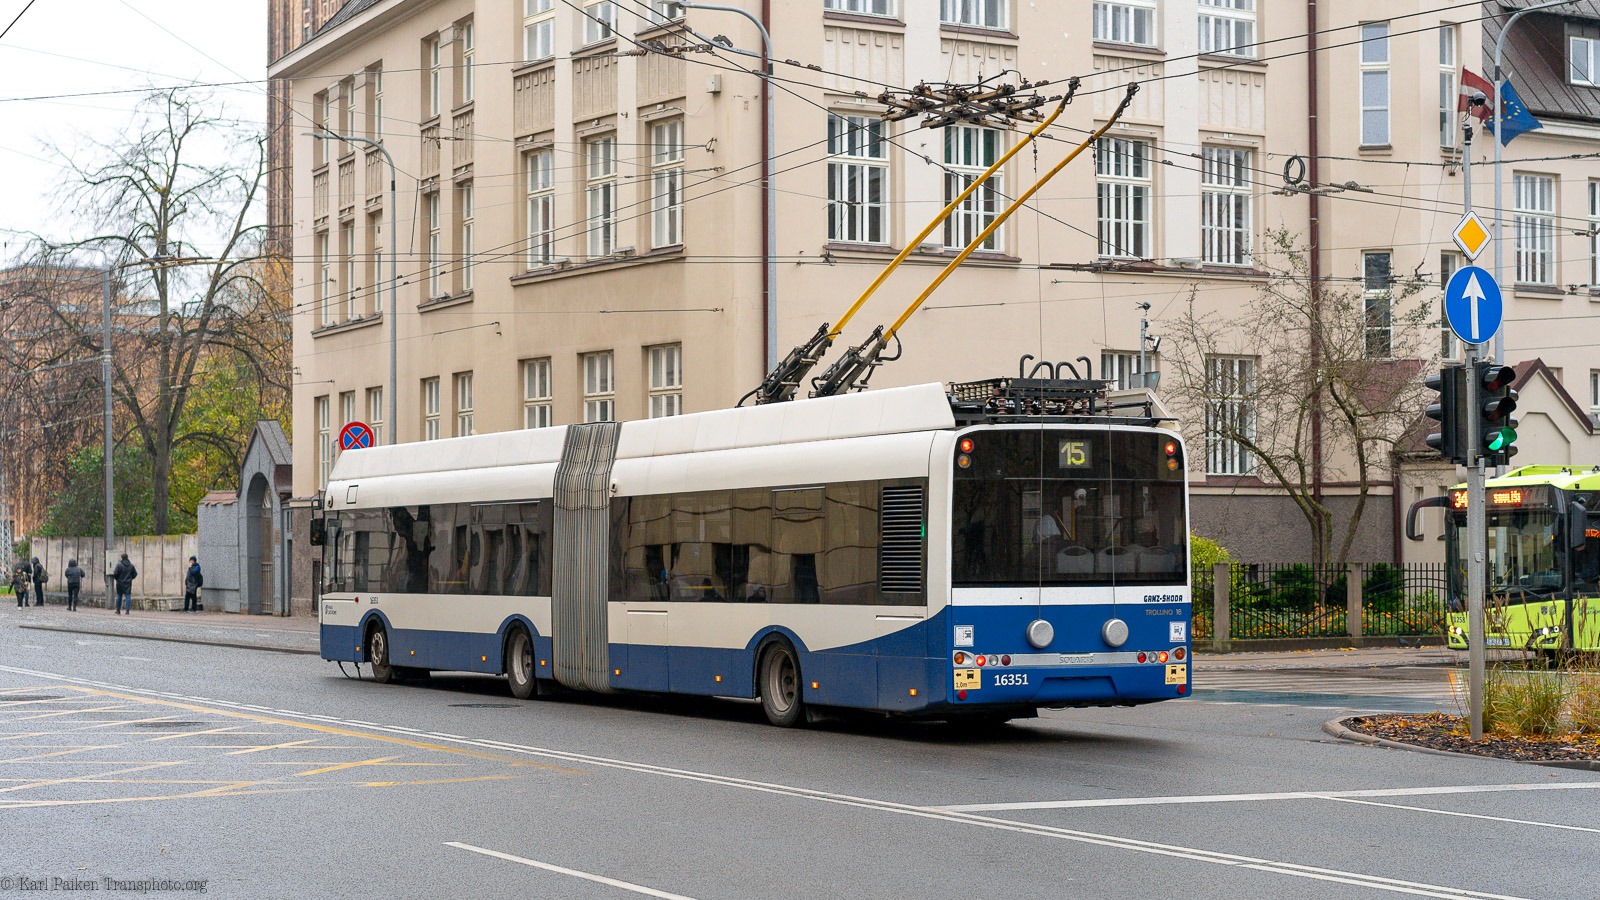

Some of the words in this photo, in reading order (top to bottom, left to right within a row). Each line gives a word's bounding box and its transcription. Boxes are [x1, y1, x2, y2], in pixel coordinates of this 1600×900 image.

[1061, 442, 1085, 465] 15
[1454, 491, 1468, 508] 34
[1145, 608, 1173, 616] TROLLINO
[1060, 656, 1094, 664] SOLARIS
[994, 673, 1029, 686] 16351
